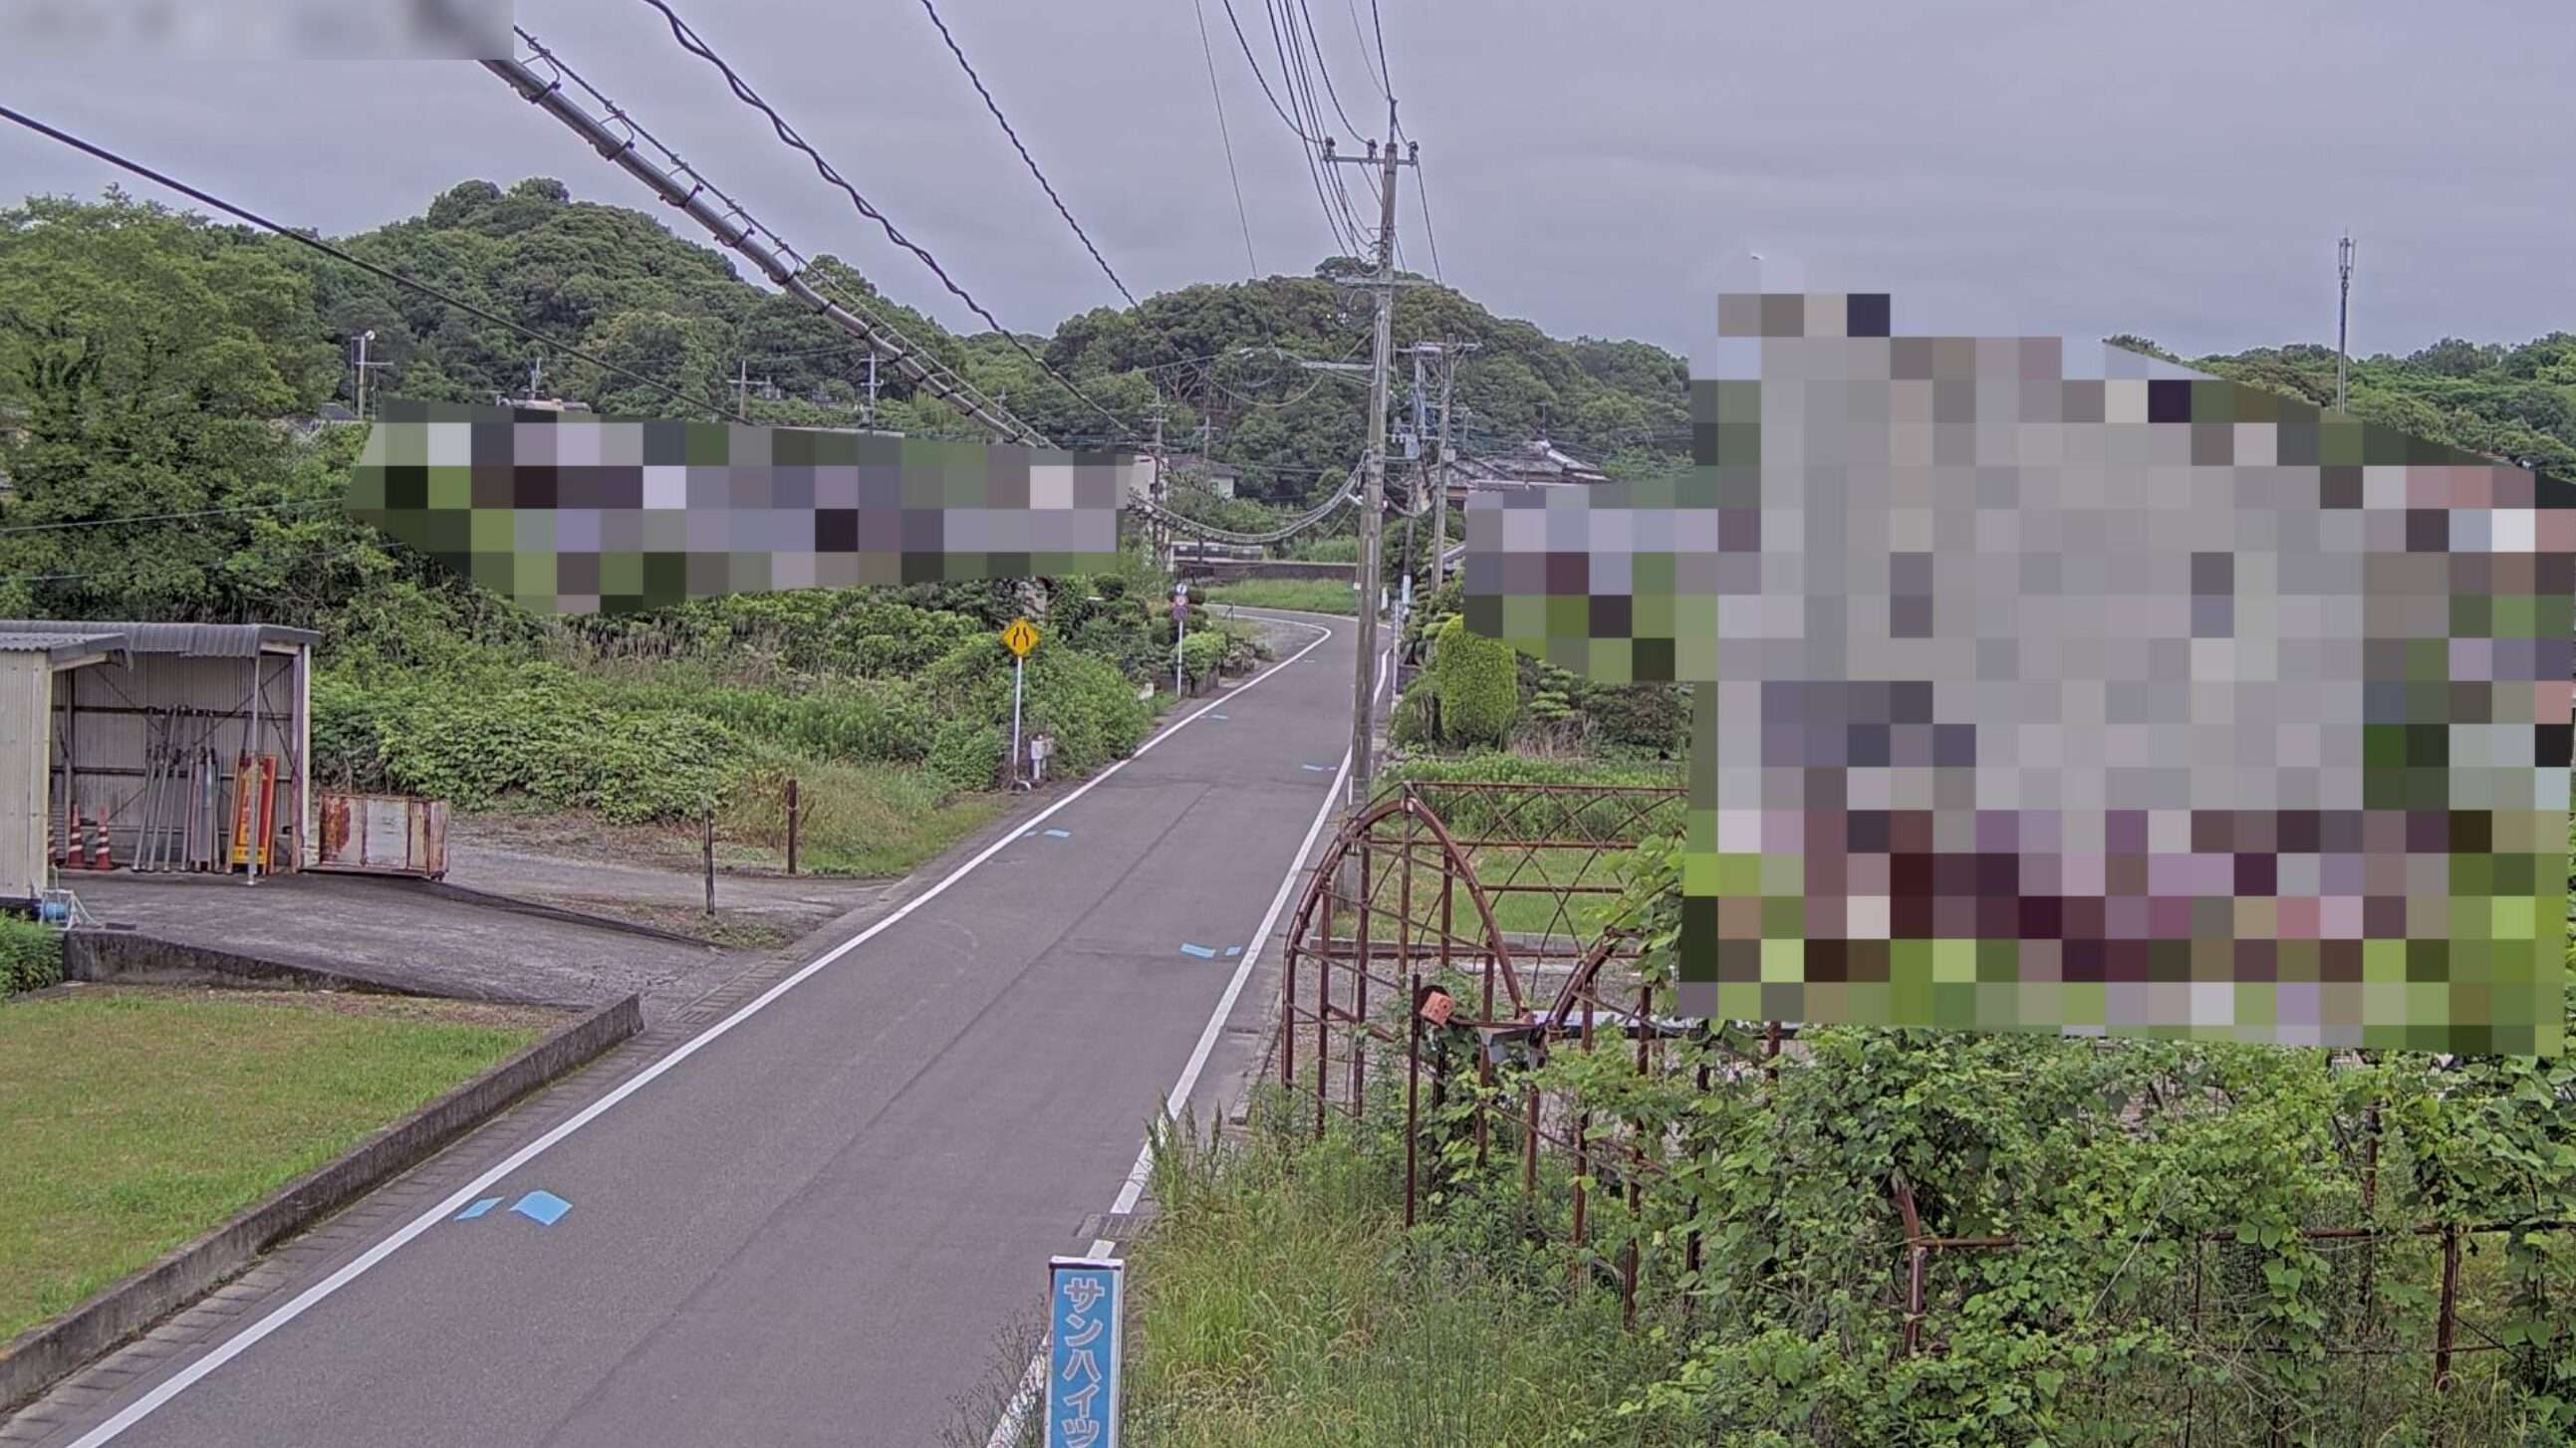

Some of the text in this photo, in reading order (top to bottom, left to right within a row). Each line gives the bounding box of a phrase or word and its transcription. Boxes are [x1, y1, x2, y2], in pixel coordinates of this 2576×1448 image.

[1062, 1278, 1105, 1448] サンハイツ
